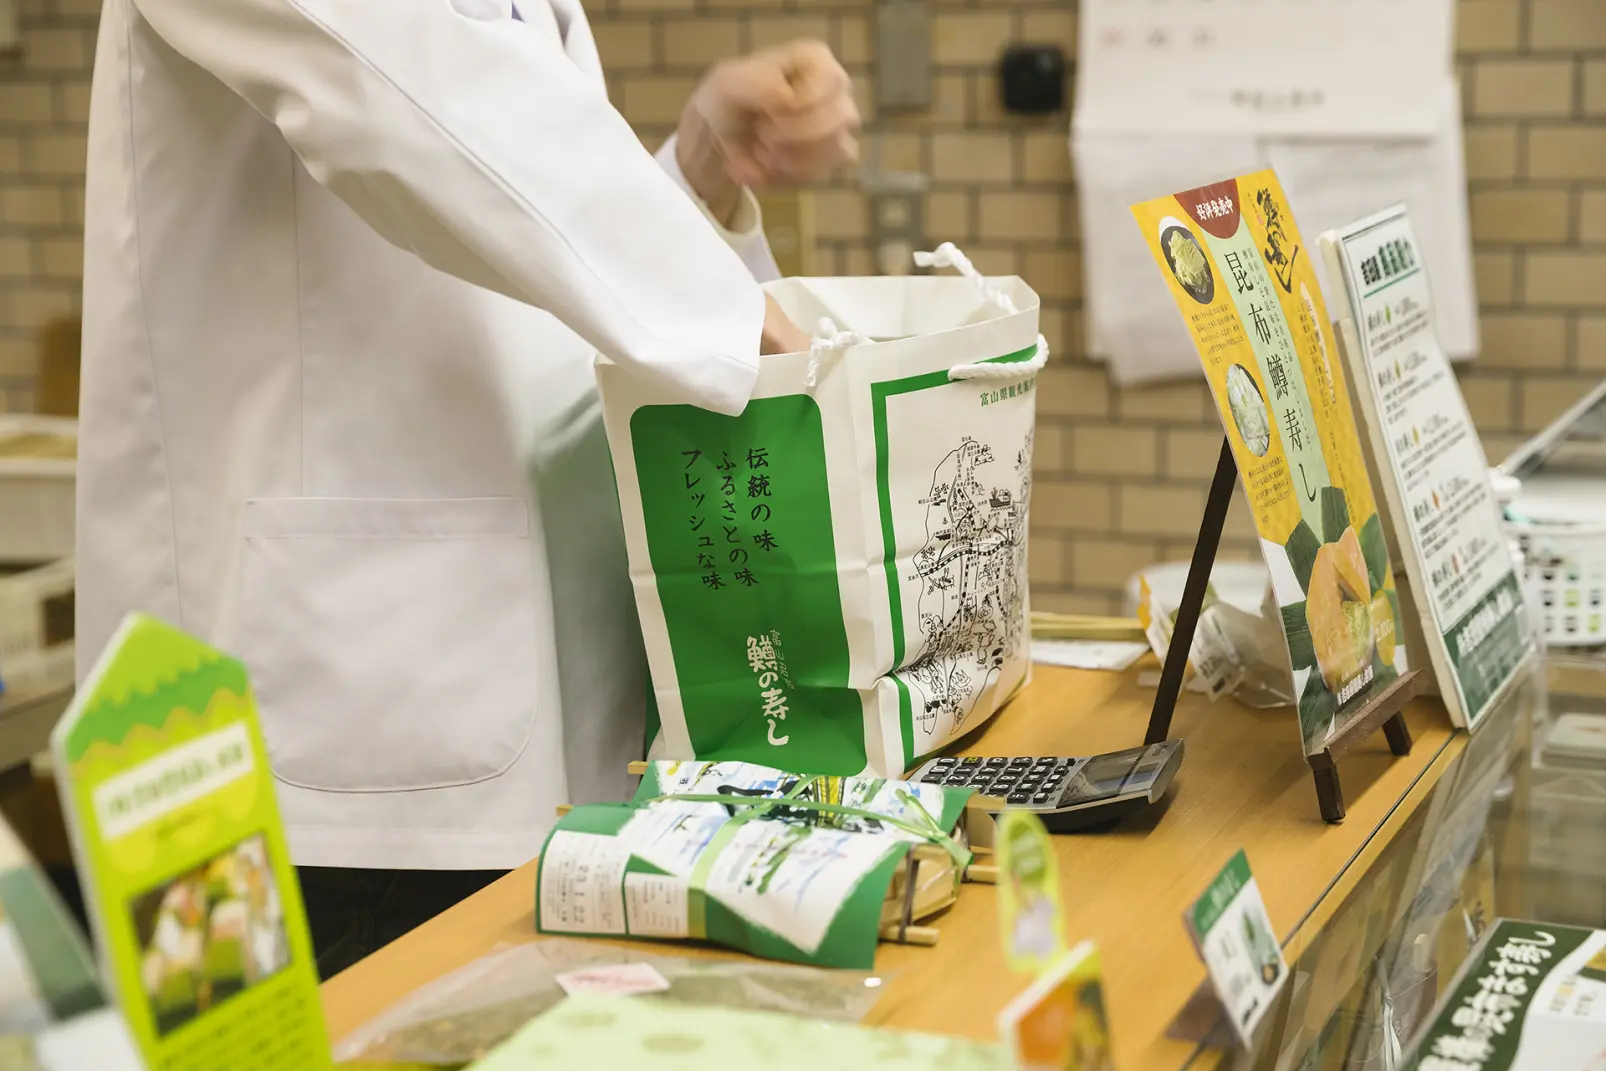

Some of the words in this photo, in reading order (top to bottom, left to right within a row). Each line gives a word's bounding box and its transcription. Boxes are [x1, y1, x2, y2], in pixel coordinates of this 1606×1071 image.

[1195, 195, 1234, 221] 好評発売中
[1223, 250, 1317, 502] 昆布鱒寿し
[681, 449, 727, 591] フレッシュな味
[715, 450, 760, 588] ふるさとの味
[745, 447, 779, 552] 伝統の味
[746, 634, 790, 746] 鱒の寿し
